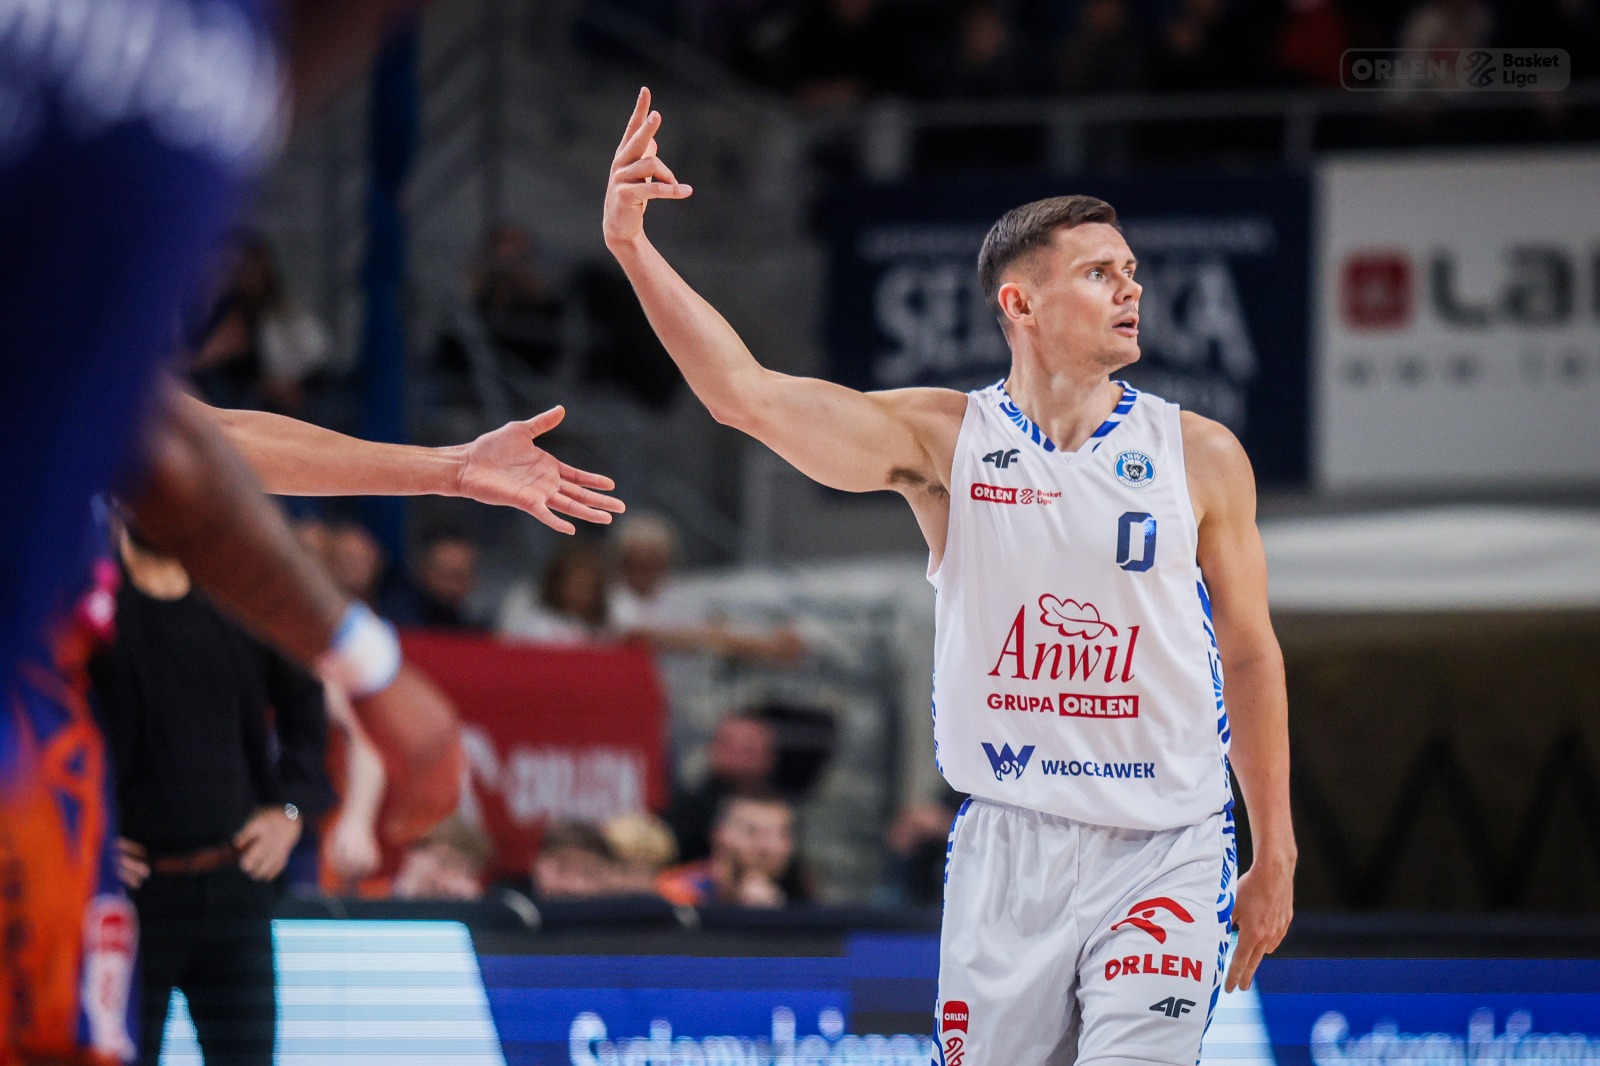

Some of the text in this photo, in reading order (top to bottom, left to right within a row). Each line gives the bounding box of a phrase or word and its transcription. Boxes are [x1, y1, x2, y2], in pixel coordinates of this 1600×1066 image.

[1119, 451, 1150, 466] ANWIL
[973, 486, 1013, 502] ORLEN
[1036, 497, 1053, 505] Liga
[1037, 489, 1062, 498] Basket
[1116, 511, 1157, 573] 0
[987, 604, 1141, 684] Anwil
[986, 693, 1134, 716] GRUPA ORLEN
[1040, 759, 1156, 779] WŁOCŁAWEK
[1104, 953, 1203, 983] ORLEN
[944, 1012, 968, 1022] ORLEN
